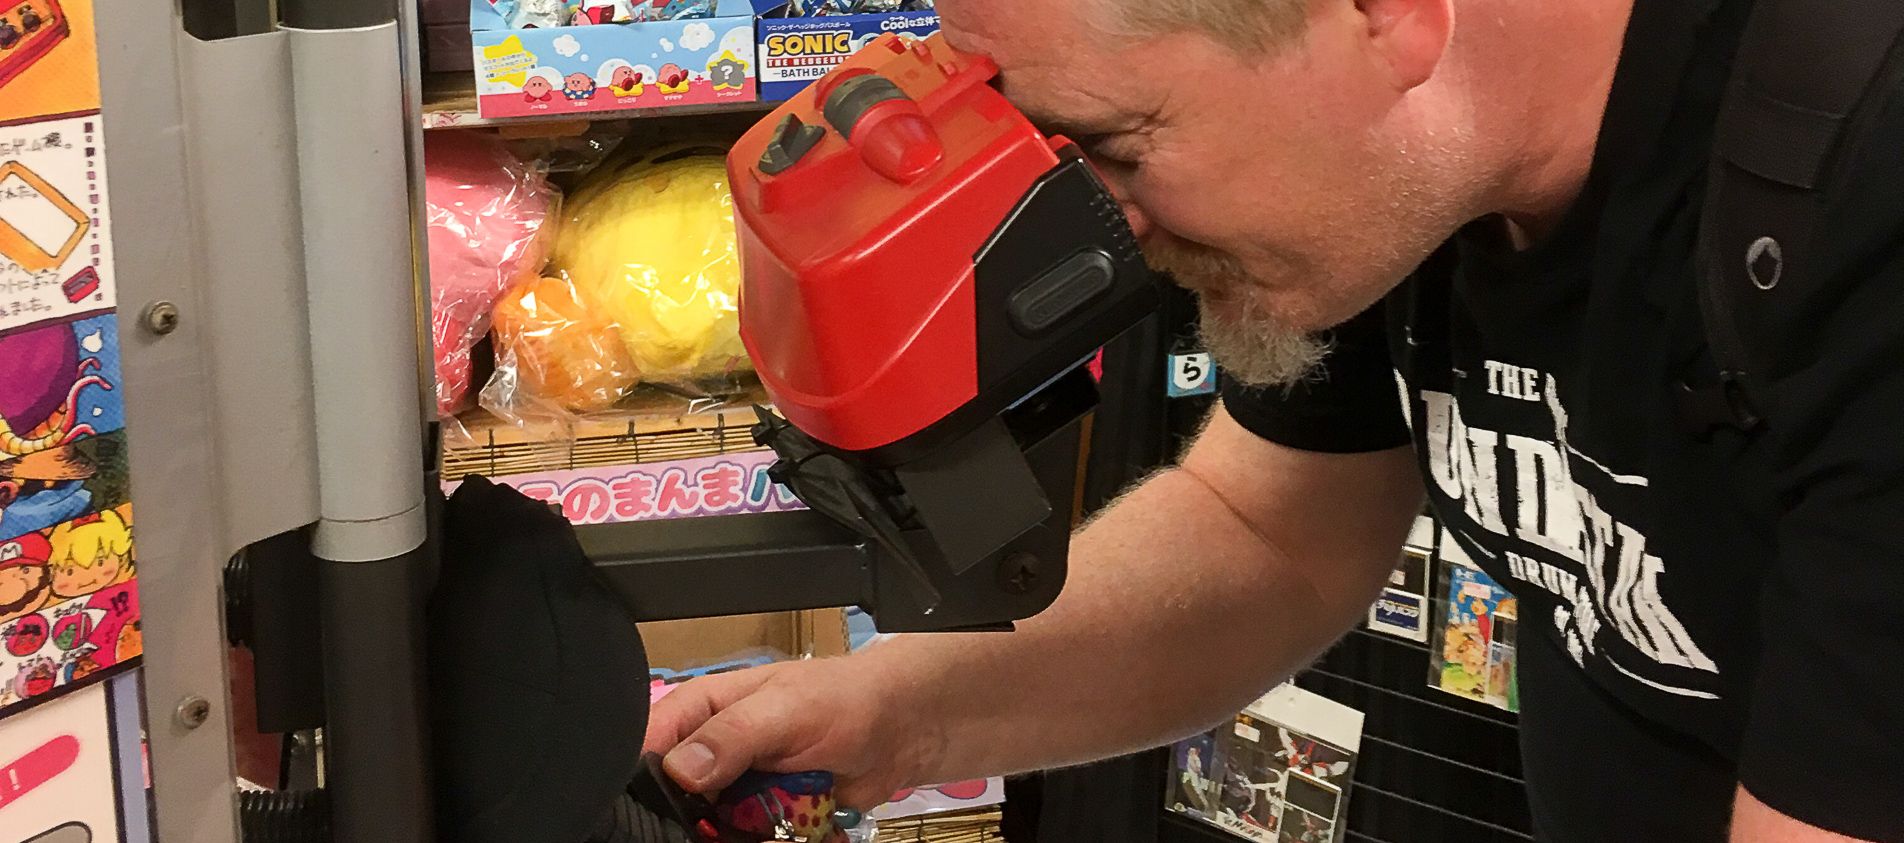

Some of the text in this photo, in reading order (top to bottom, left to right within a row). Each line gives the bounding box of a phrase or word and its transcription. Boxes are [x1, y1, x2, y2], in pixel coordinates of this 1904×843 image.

[767, 33, 850, 56] SONIC
[768, 56, 848, 67] THE HEDGEHO
[781, 68, 810, 78] BATH
[1183, 357, 1201, 382] ら
[1484, 360, 1541, 402] THE
